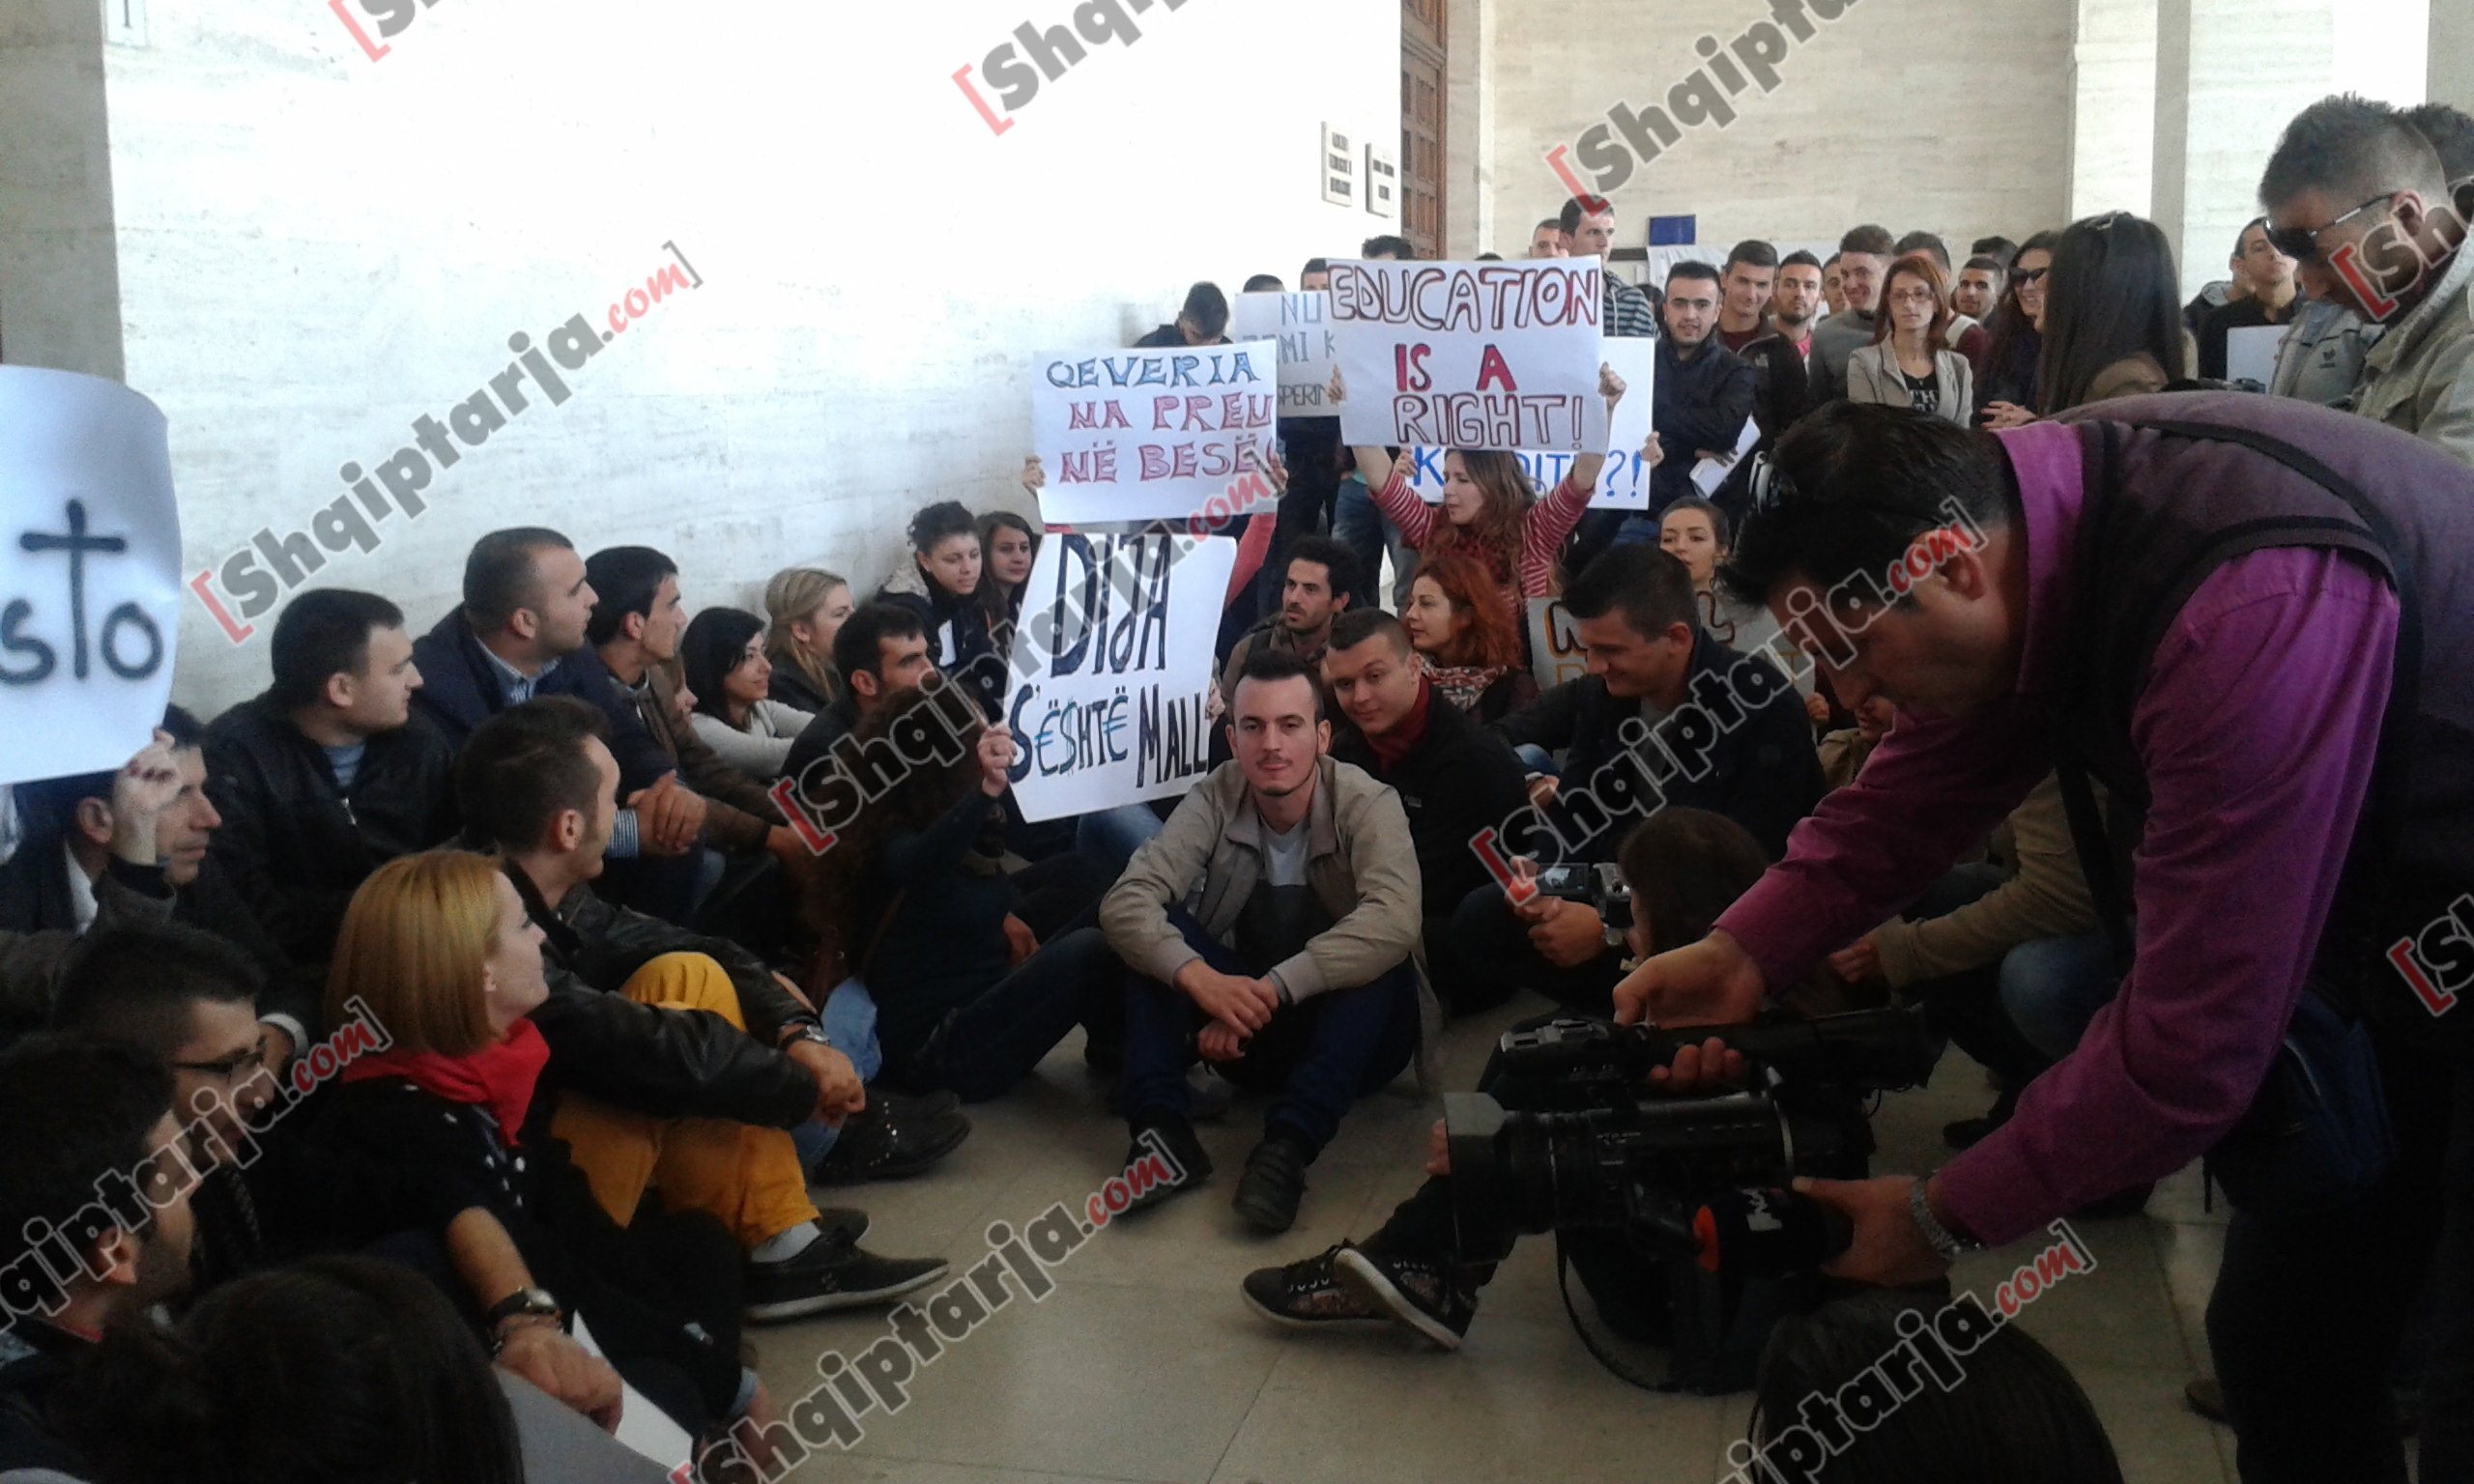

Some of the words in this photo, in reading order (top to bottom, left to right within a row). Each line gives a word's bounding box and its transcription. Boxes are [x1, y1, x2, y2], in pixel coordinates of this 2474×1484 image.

[1328, 265, 1597, 332] EDUCATION
[1046, 351, 1261, 388] QEVERIA
[1394, 343, 1432, 392] IS
[1475, 344, 1518, 392] A
[1069, 399, 1134, 431] NA
[1393, 392, 1583, 449] RIGHT!
[1059, 440, 1118, 484] NË
[1050, 532, 1172, 678] DIJA
[1136, 682, 1208, 788] MALL
